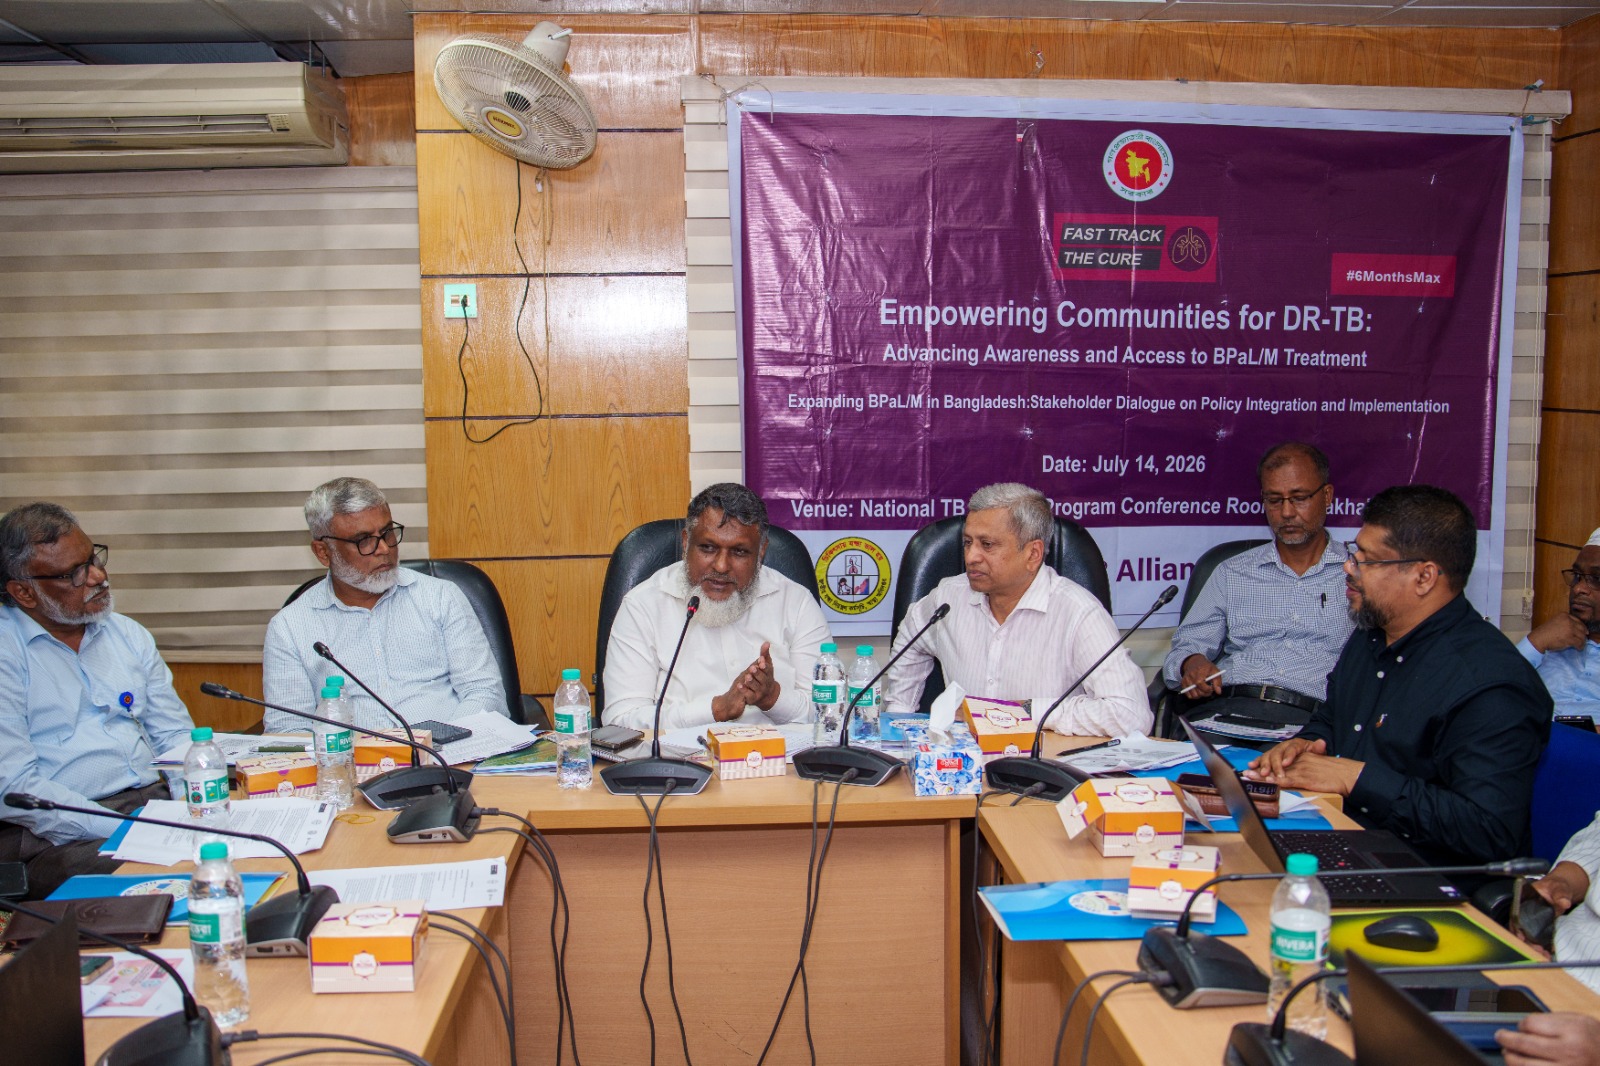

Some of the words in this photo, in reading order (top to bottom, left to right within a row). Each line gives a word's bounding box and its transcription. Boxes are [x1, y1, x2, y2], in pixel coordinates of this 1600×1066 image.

[1063, 227, 1105, 241] FAST
[1108, 228, 1163, 242] TRACK
[1064, 251, 1095, 265] THE
[1098, 252, 1142, 266] CURE
[1346, 270, 1441, 284] #6MonthsMax
[880, 299, 1048, 333] Empowering
[1057, 300, 1230, 330] Communities
[1239, 304, 1275, 330] for
[1284, 306, 1371, 331] DR-TB:
[883, 344, 979, 366] Advancing
[984, 345, 1079, 362] Awareness
[1086, 346, 1117, 362] and
[1122, 346, 1185, 363] Access
[1191, 348, 1207, 364] to
[1214, 348, 1278, 365] BPaL/M
[1284, 349, 1367, 366] Treatment
[788, 394, 864, 412] Expanding
[868, 394, 922, 409] BPaL/M
[927, 395, 939, 408] in
[1116, 396, 1175, 413] Dialogue
[1180, 399, 1197, 410] on
[1201, 397, 1242, 414] Policy
[1246, 397, 1316, 414] Integration
[1321, 399, 1345, 411] and
[1350, 399, 1449, 414] Implementation
[1043, 455, 1086, 472] Date:
[1093, 455, 1129, 476] July
[1136, 455, 1158, 475] 14,
[1165, 455, 1205, 472] 2026
[791, 499, 853, 517] Venue:
[861, 499, 934, 517] National
[941, 499, 965, 516] TB
[1121, 497, 1220, 514] Conference
[1226, 496, 1265, 514] Roo
[1116, 557, 1196, 582] Allian
[1275, 936, 1315, 951] RIVERA
